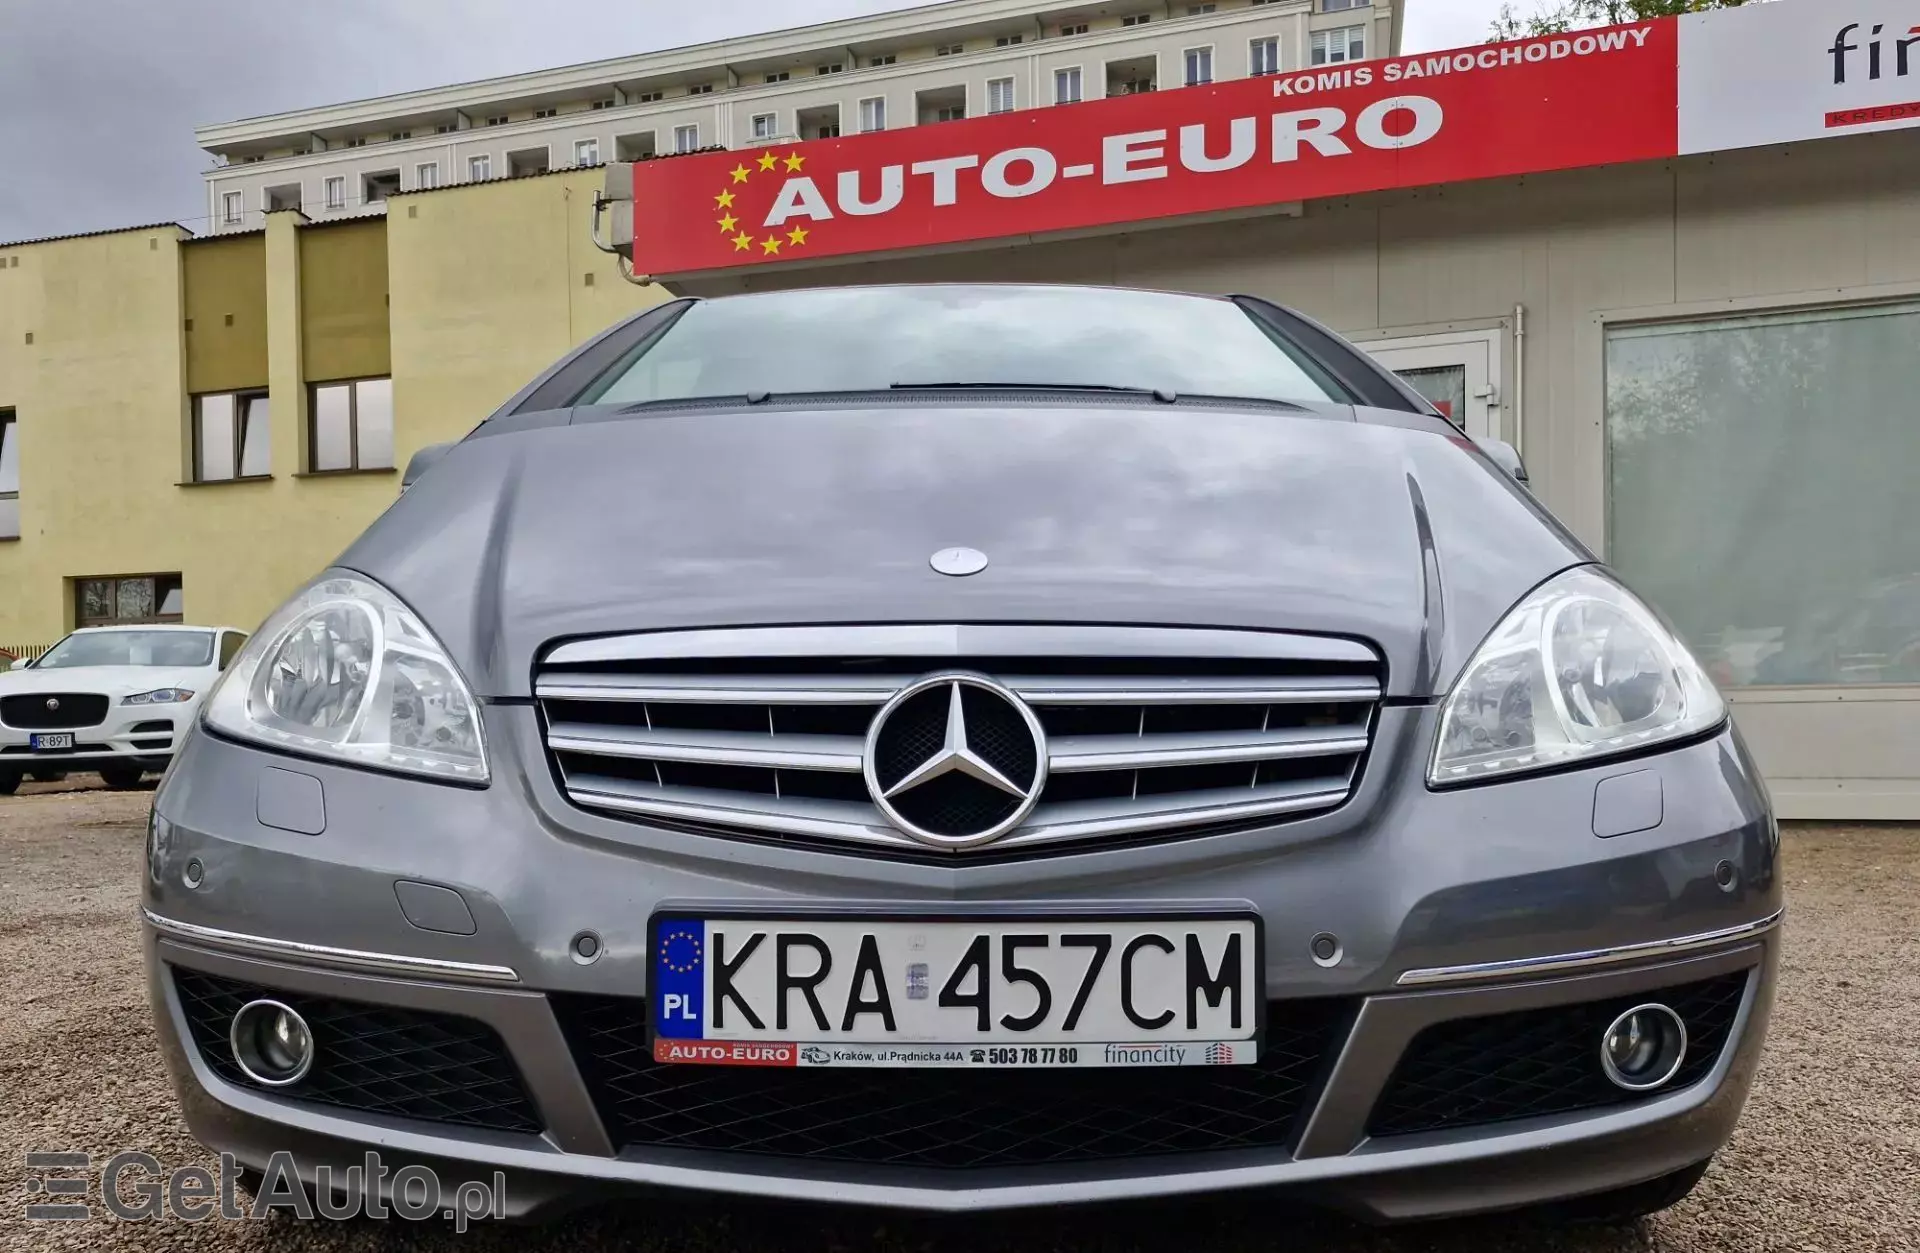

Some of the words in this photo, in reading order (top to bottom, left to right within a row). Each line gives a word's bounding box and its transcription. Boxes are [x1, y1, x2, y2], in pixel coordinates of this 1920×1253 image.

[1273, 67, 1373, 97] KOMIS
[1383, 27, 1652, 82] SAMOCHODOWY
[762, 96, 1444, 227] AUTO-EURO
[49, 735, 70, 747] 89T
[712, 932, 897, 1032] KRA
[938, 932, 1242, 1032] 457CM
[664, 994, 697, 1020] PL
[669, 1046, 790, 1061] AUTO-EURO
[833, 1050, 875, 1062] Kraków,
[877, 1050, 941, 1063] ul.Prądnicka
[943, 1051, 964, 1061] 44A
[989, 1047, 1018, 1064] 503
[1020, 1047, 1038, 1064] 78
[1040, 1047, 1056, 1064] 77
[1059, 1047, 1078, 1064] 80
[1104, 1043, 1186, 1065] financity
